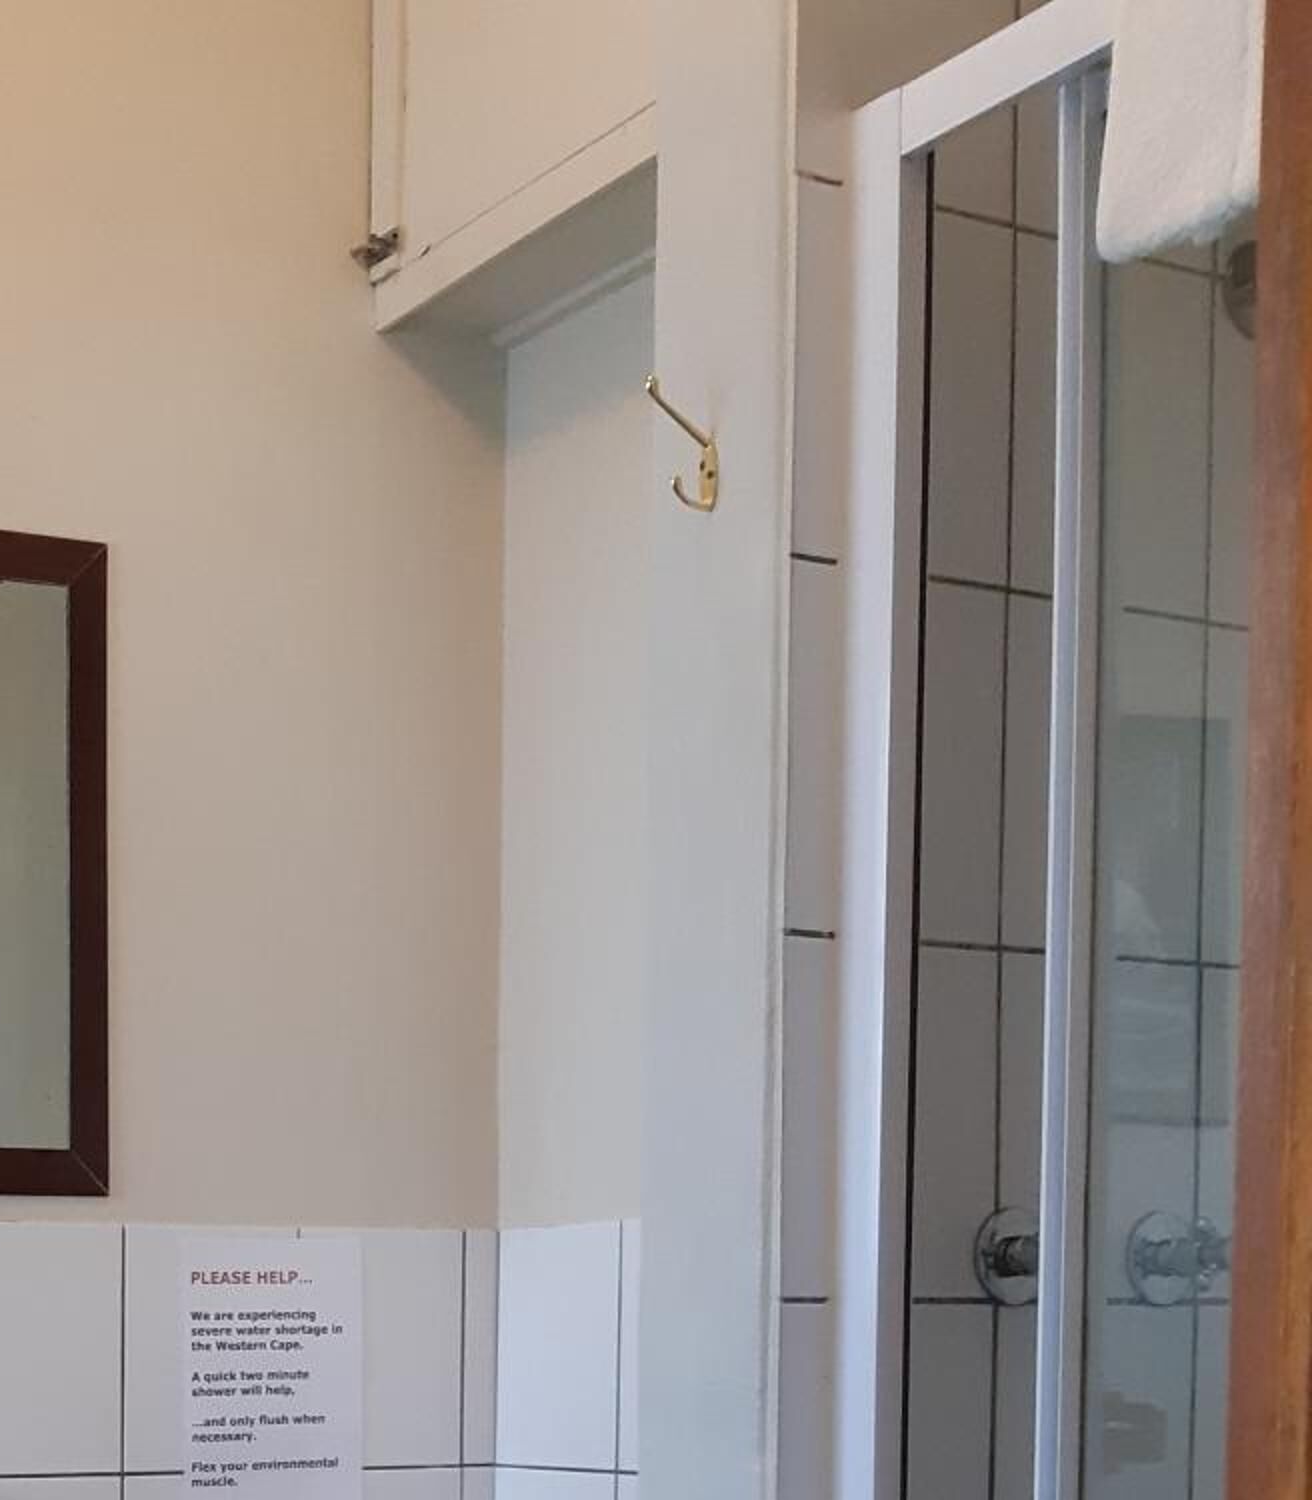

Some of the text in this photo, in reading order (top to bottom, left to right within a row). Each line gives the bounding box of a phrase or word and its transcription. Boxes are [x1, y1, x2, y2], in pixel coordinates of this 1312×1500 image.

[191, 1271, 251, 1285] PLEASE
[190, 1310, 316, 1322] We are experiencing
[191, 1324, 343, 1337] severe water shortage in
[191, 1340, 304, 1352] the Western Cape.
[191, 1370, 309, 1383] A quick two minute
[191, 1386, 236, 1397] shower
[240, 1385, 263, 1395] will
[229, 1415, 255, 1427] only
[259, 1414, 288, 1425] flush
[292, 1413, 325, 1424] when
[191, 1432, 256, 1443] necessary.
[191, 1457, 339, 1473] Flex your environmental
[191, 1476, 238, 1487] muscle.
